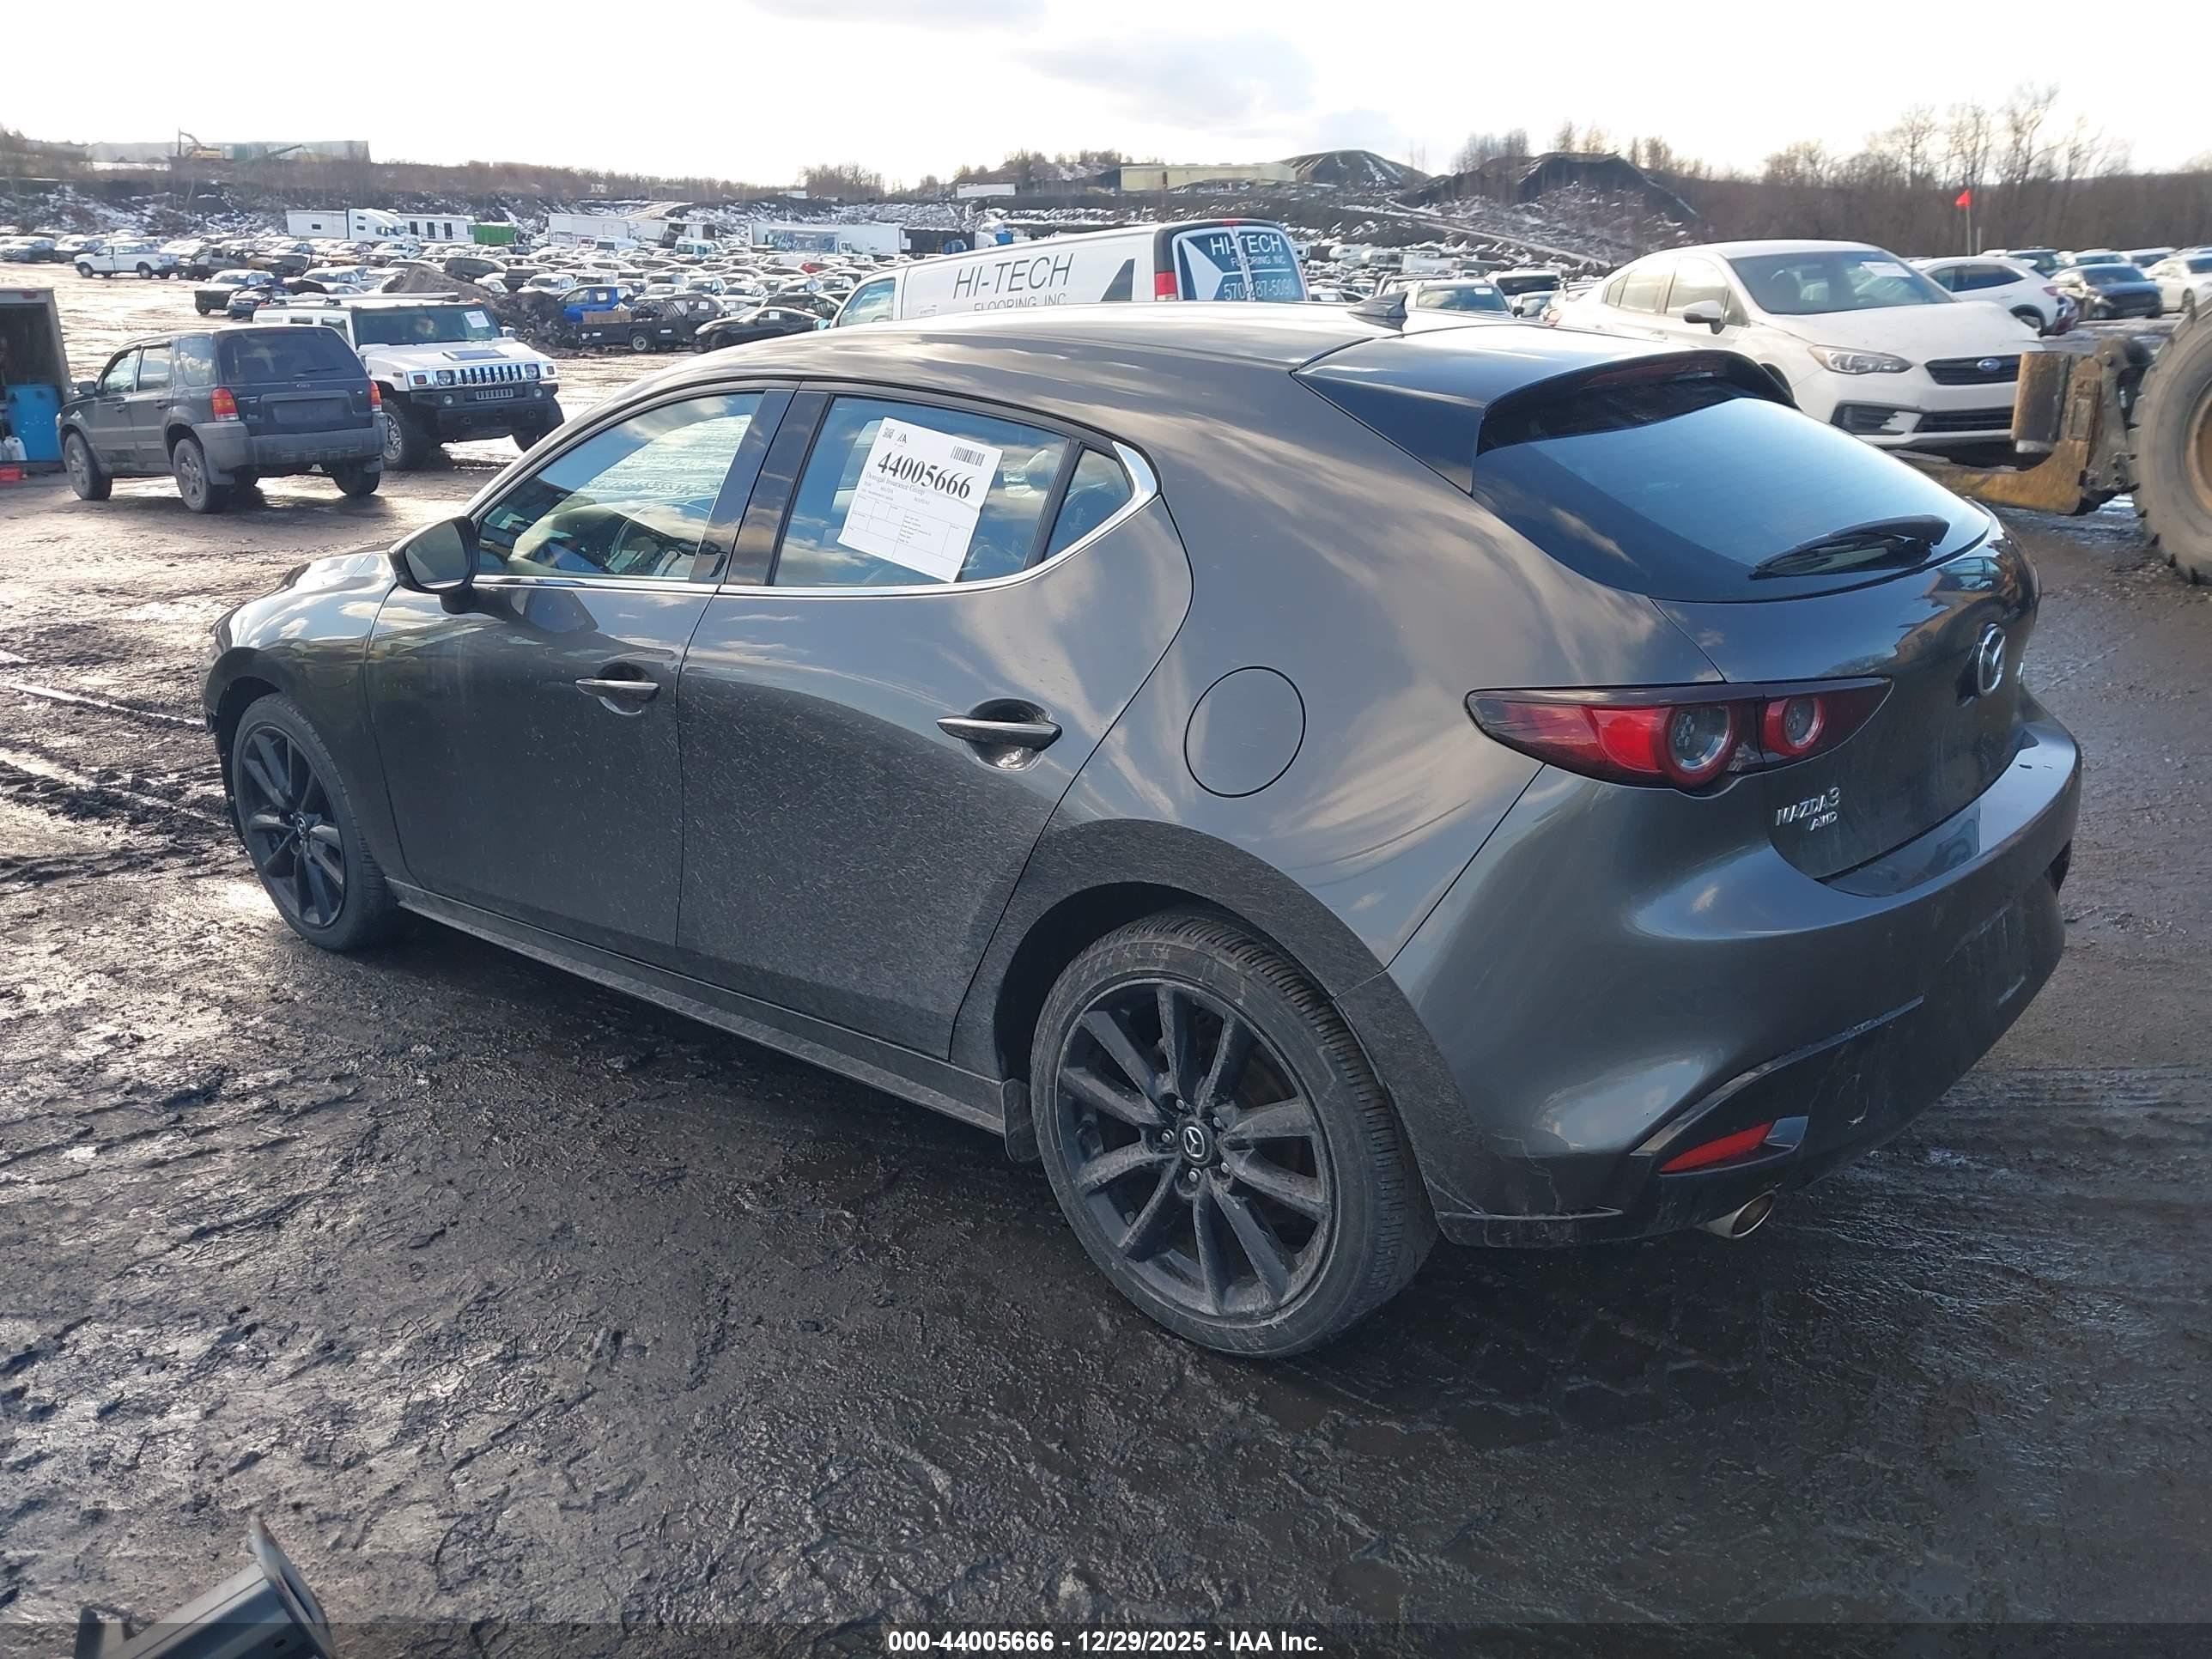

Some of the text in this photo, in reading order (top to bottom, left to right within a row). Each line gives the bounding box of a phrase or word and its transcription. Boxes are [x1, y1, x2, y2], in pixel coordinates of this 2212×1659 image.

[1210, 234, 1283, 256] HI-TECH
[953, 252, 1074, 300] HI-TECH
[878, 452, 975, 499] 44005666
